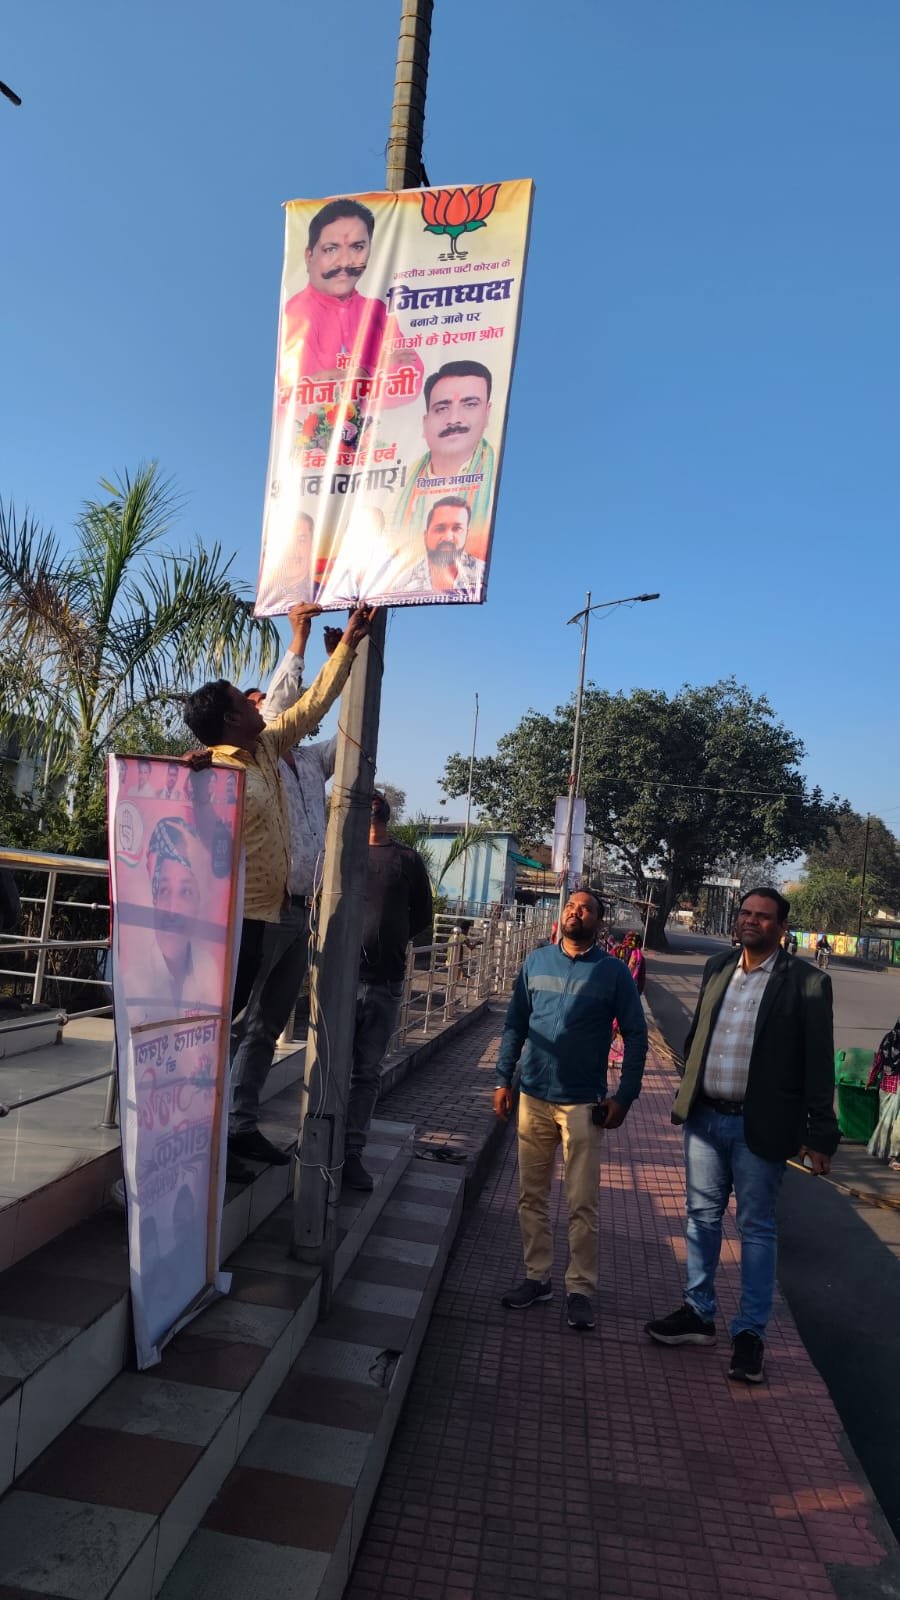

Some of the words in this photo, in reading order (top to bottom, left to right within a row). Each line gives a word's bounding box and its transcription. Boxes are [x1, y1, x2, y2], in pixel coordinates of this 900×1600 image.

[427, 266, 451, 277] जनता
[454, 262, 471, 274] पार्टी
[473, 260, 500, 272] कोरबा
[386, 278, 514, 313] जिलाध्यक्ष
[410, 314, 439, 328] बनाये
[441, 312, 463, 325] जाने
[466, 311, 481, 322] पर
[425, 332, 440, 346] के
[442, 330, 476, 347] प्रेरणा
[479, 325, 505, 342] श्रोत
[386, 366, 420, 397] जी
